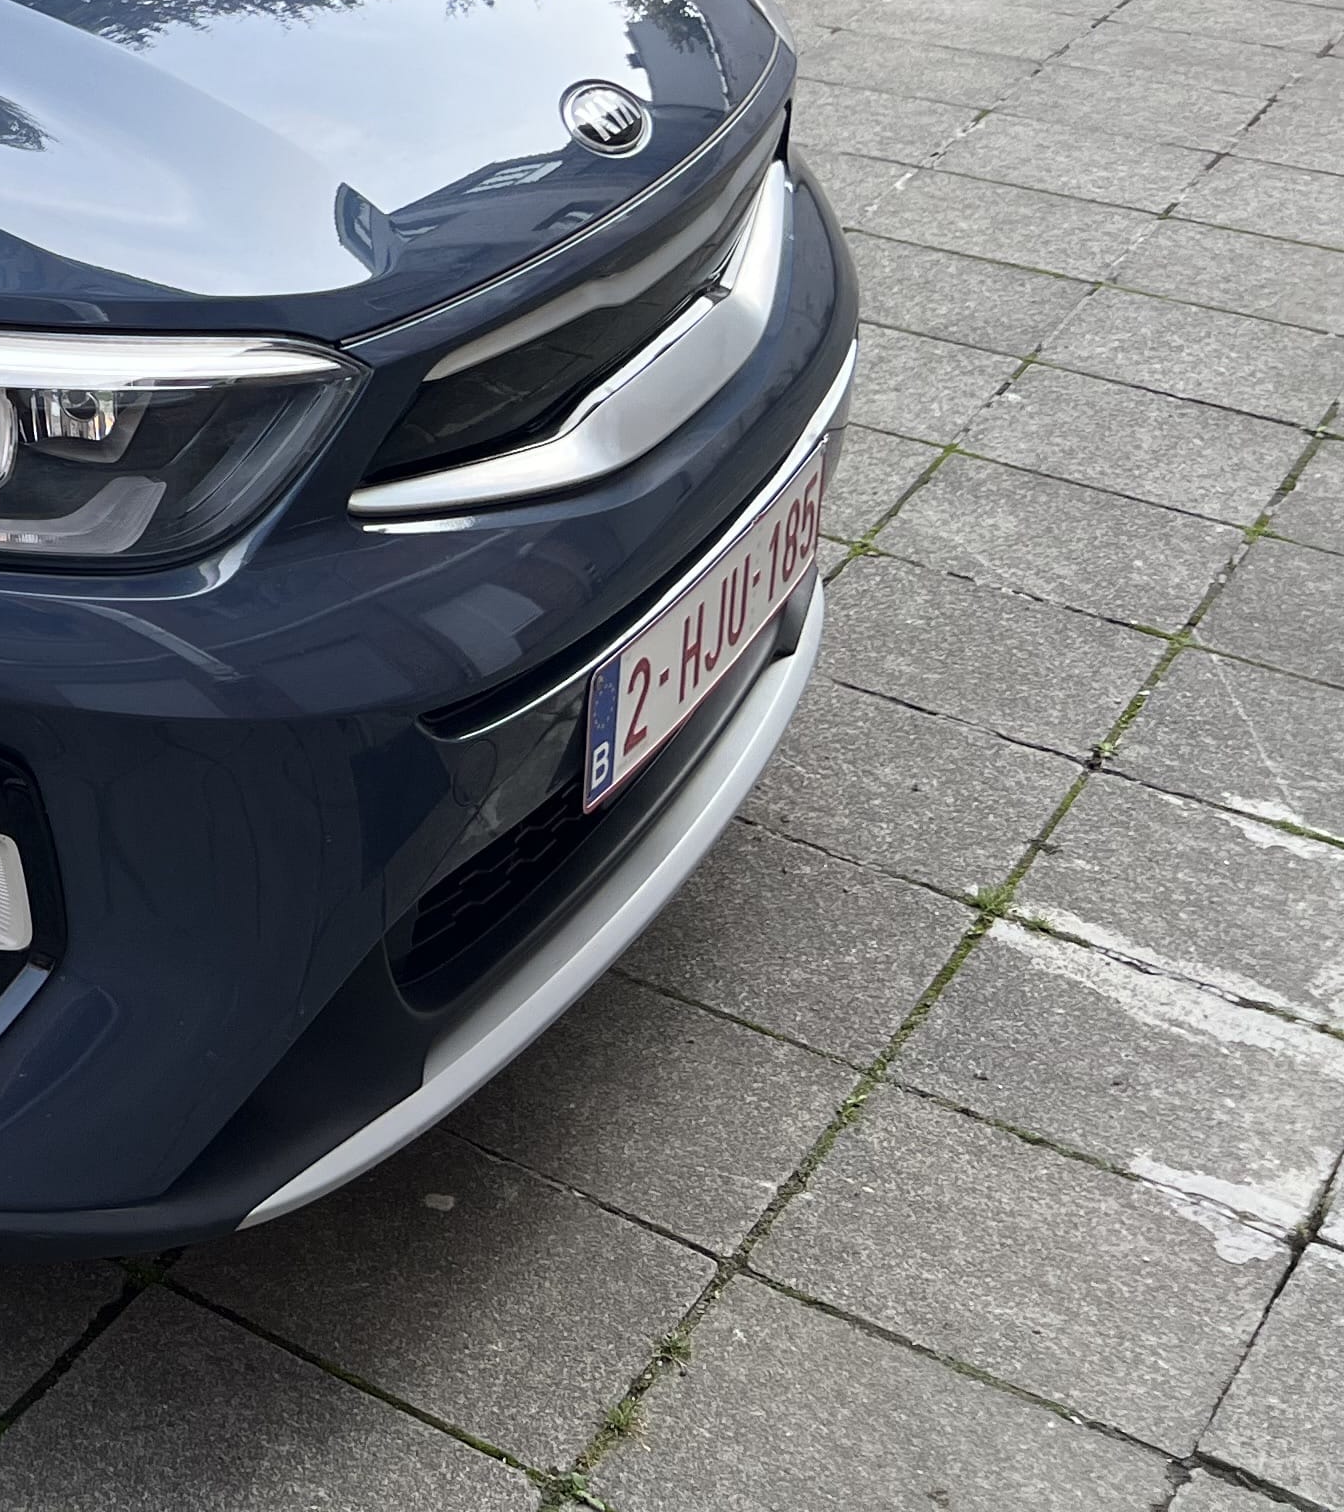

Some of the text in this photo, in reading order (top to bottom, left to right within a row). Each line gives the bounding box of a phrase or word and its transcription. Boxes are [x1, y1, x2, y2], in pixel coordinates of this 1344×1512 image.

[574, 94, 641, 142] KIA
[622, 473, 818, 757] 2-HJU-185
[591, 743, 610, 789] B
